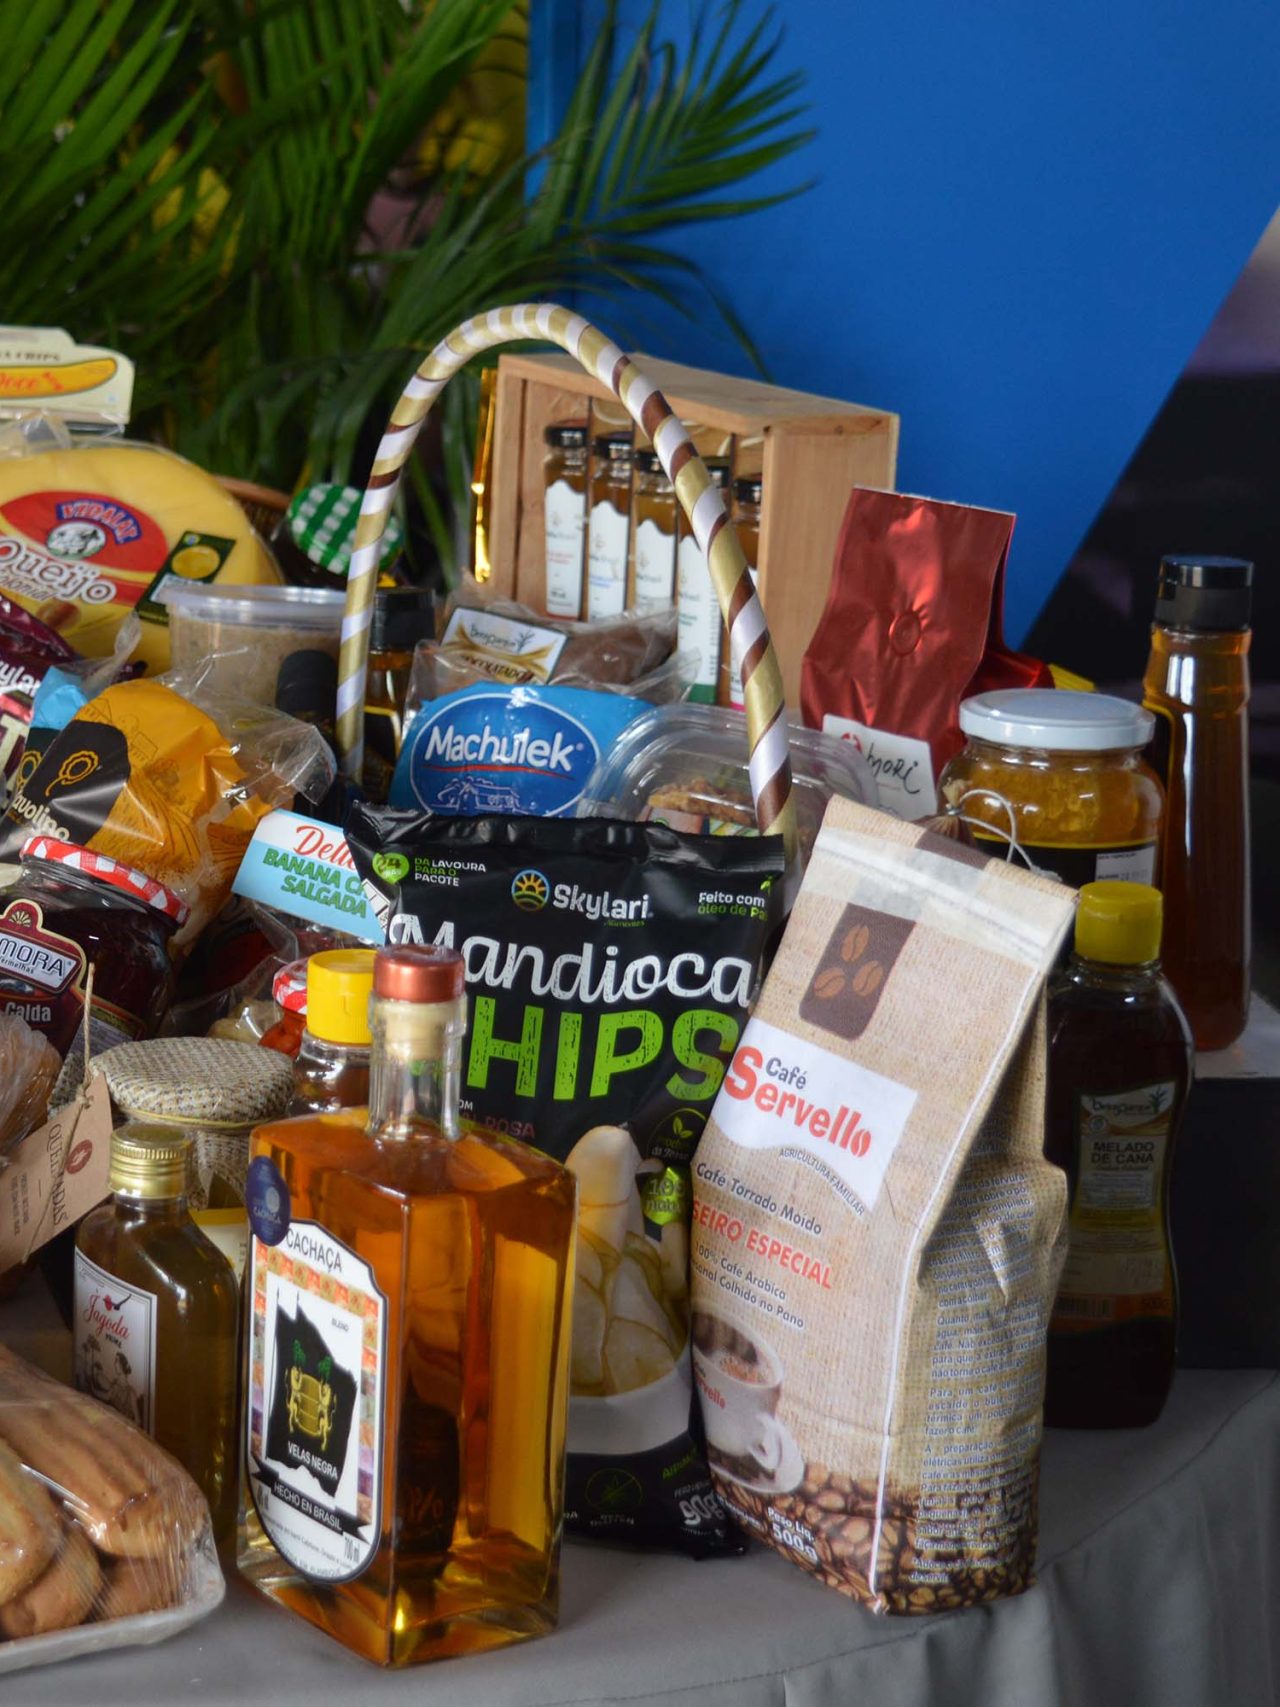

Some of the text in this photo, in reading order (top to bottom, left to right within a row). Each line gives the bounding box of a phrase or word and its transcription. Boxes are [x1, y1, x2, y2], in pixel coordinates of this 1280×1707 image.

[15, 352, 61, 362] CHIPS
[424, 723, 572, 772] Machulek
[262, 847, 342, 890] BANANA
[414, 857, 487, 873] DA LAVOURA
[414, 865, 445, 876] PARA
[448, 867, 457, 877] O
[414, 872, 460, 887] PACOTE
[280, 873, 367, 918] SALGADA
[552, 883, 650, 922] Skylari
[698, 891, 766, 908] Feito com
[729, 904, 746, 916] de
[388, 912, 753, 1009] Mandioca
[4, 1001, 52, 1023] Calda
[766, 1056, 808, 1091] Café
[723, 1045, 873, 1159] Servello
[1090, 1151, 1155, 1165] DE CANA
[1093, 1140, 1155, 1153] MELADO
[779, 1146, 866, 1217] AGRICULTURA FAMILIAR
[978, 1190, 1005, 1203] sobre
[991, 1172, 1026, 1187] fervura
[696, 1161, 823, 1236] Café Torrado Moído
[285, 1227, 343, 1274] CACHAÇA
[720, 1257, 744, 1278] Café
[747, 1229, 834, 1290] ESPECIAL
[83, 1293, 130, 1340] Jagoda
[719, 1275, 757, 1306] Colhido
[759, 1299, 773, 1314] no
[775, 1306, 805, 1329] Pano
[936, 1315, 969, 1326] Quanto
[932, 1354, 953, 1365] para
[930, 1388, 953, 1398] Para
[958, 1387, 974, 1396] um
[978, 1383, 998, 1394] café
[287, 1440, 338, 1479] VELAS NEGRA
[943, 1441, 994, 1454] preparação
[273, 1480, 343, 1531] HECHO EN BRASIL
[767, 1505, 793, 1532] Peso
[795, 1520, 816, 1542] Líq.
[771, 1523, 818, 1564] 500g
